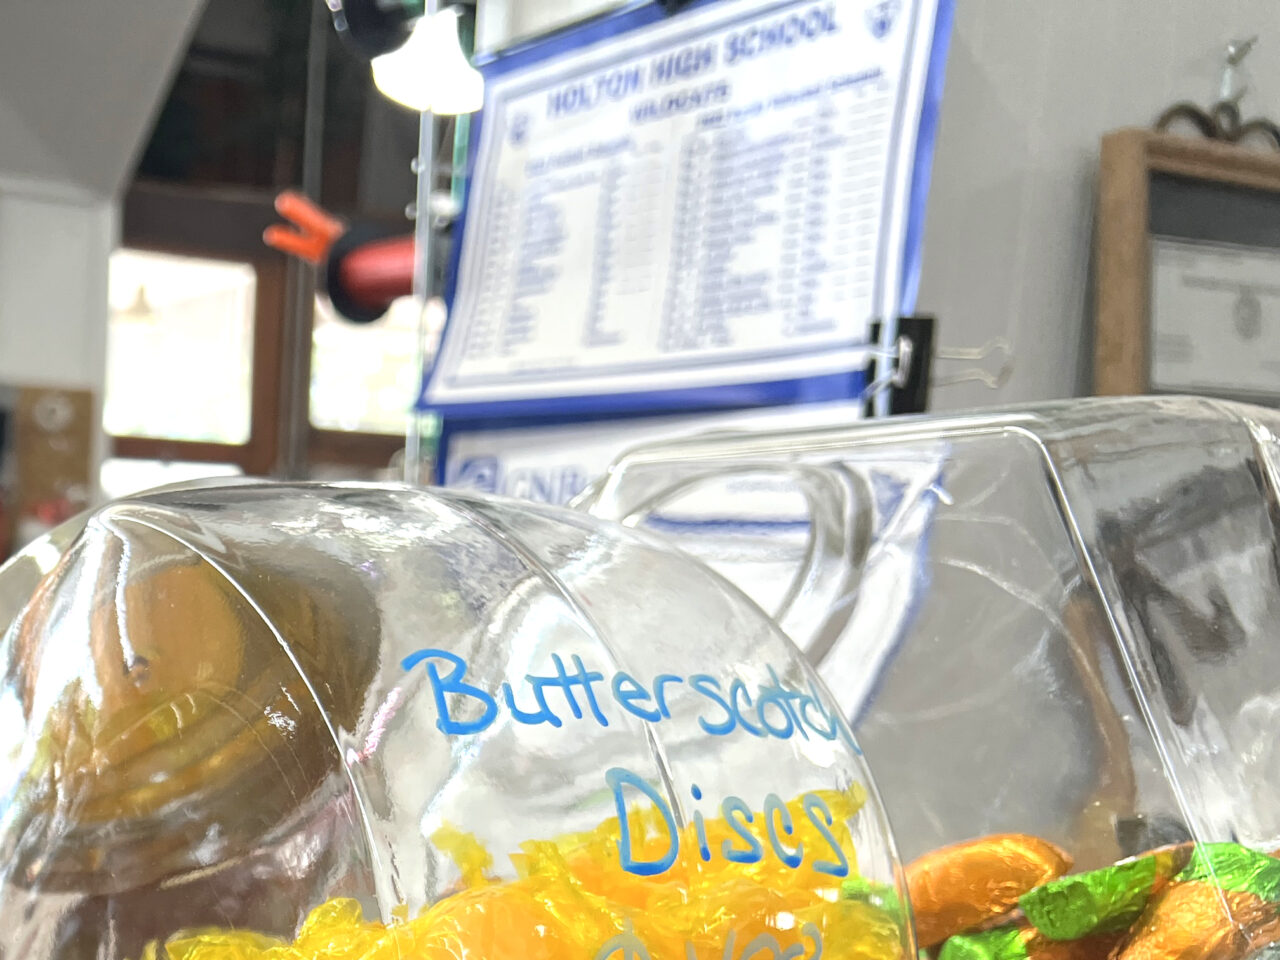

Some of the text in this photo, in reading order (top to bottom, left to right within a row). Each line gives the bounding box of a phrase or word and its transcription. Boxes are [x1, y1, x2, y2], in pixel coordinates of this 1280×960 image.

[546, 6, 837, 119] HOLTON HIGH SCHOOL
[605, 767, 849, 878] Discs
